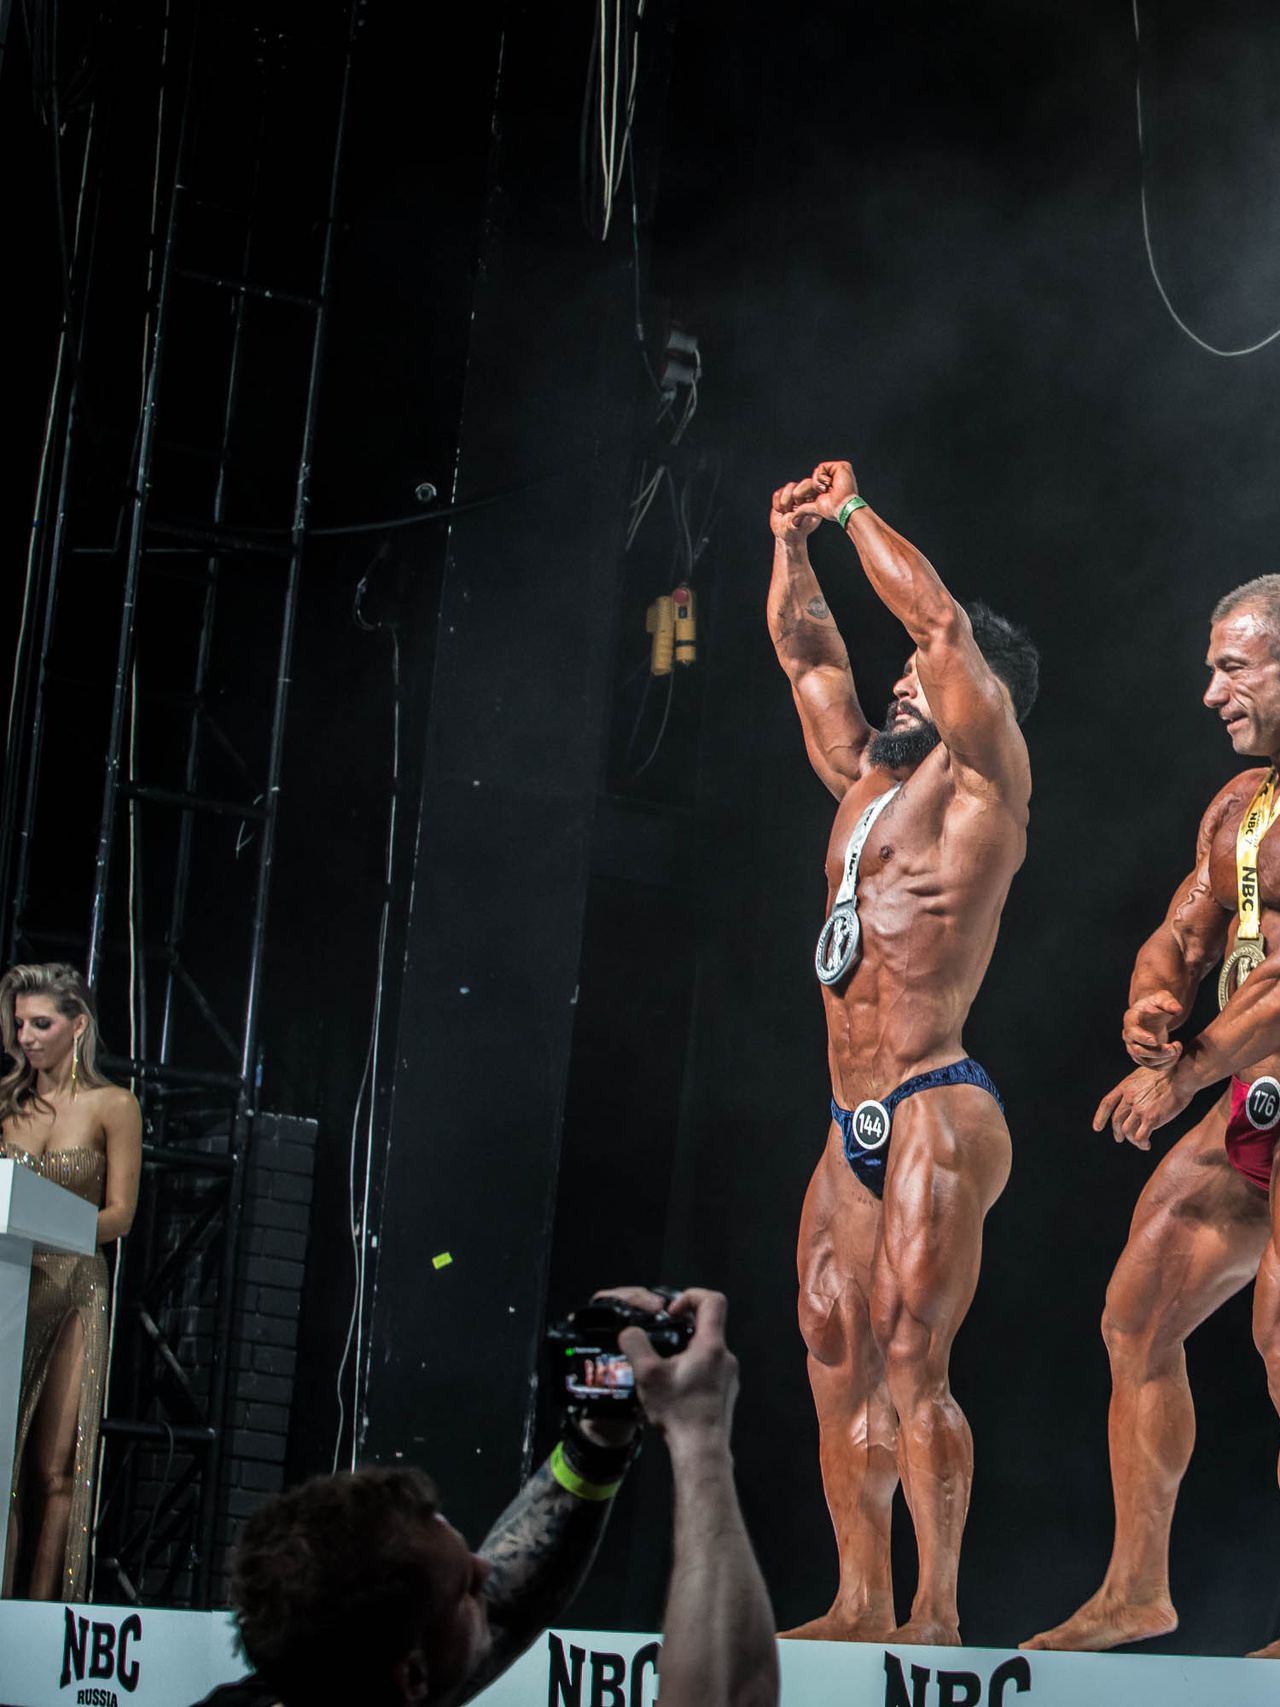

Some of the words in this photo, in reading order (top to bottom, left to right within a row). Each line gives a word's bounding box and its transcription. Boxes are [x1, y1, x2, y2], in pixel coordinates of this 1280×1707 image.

[1245, 811, 1258, 835] NBC
[1242, 866, 1257, 912] NBC
[1253, 1089, 1277, 1118] 176
[859, 1112, 883, 1138] 144
[59, 1605, 142, 1693] NBC
[547, 1631, 662, 1707] NBC
[77, 1688, 119, 1707] RUSSIA
